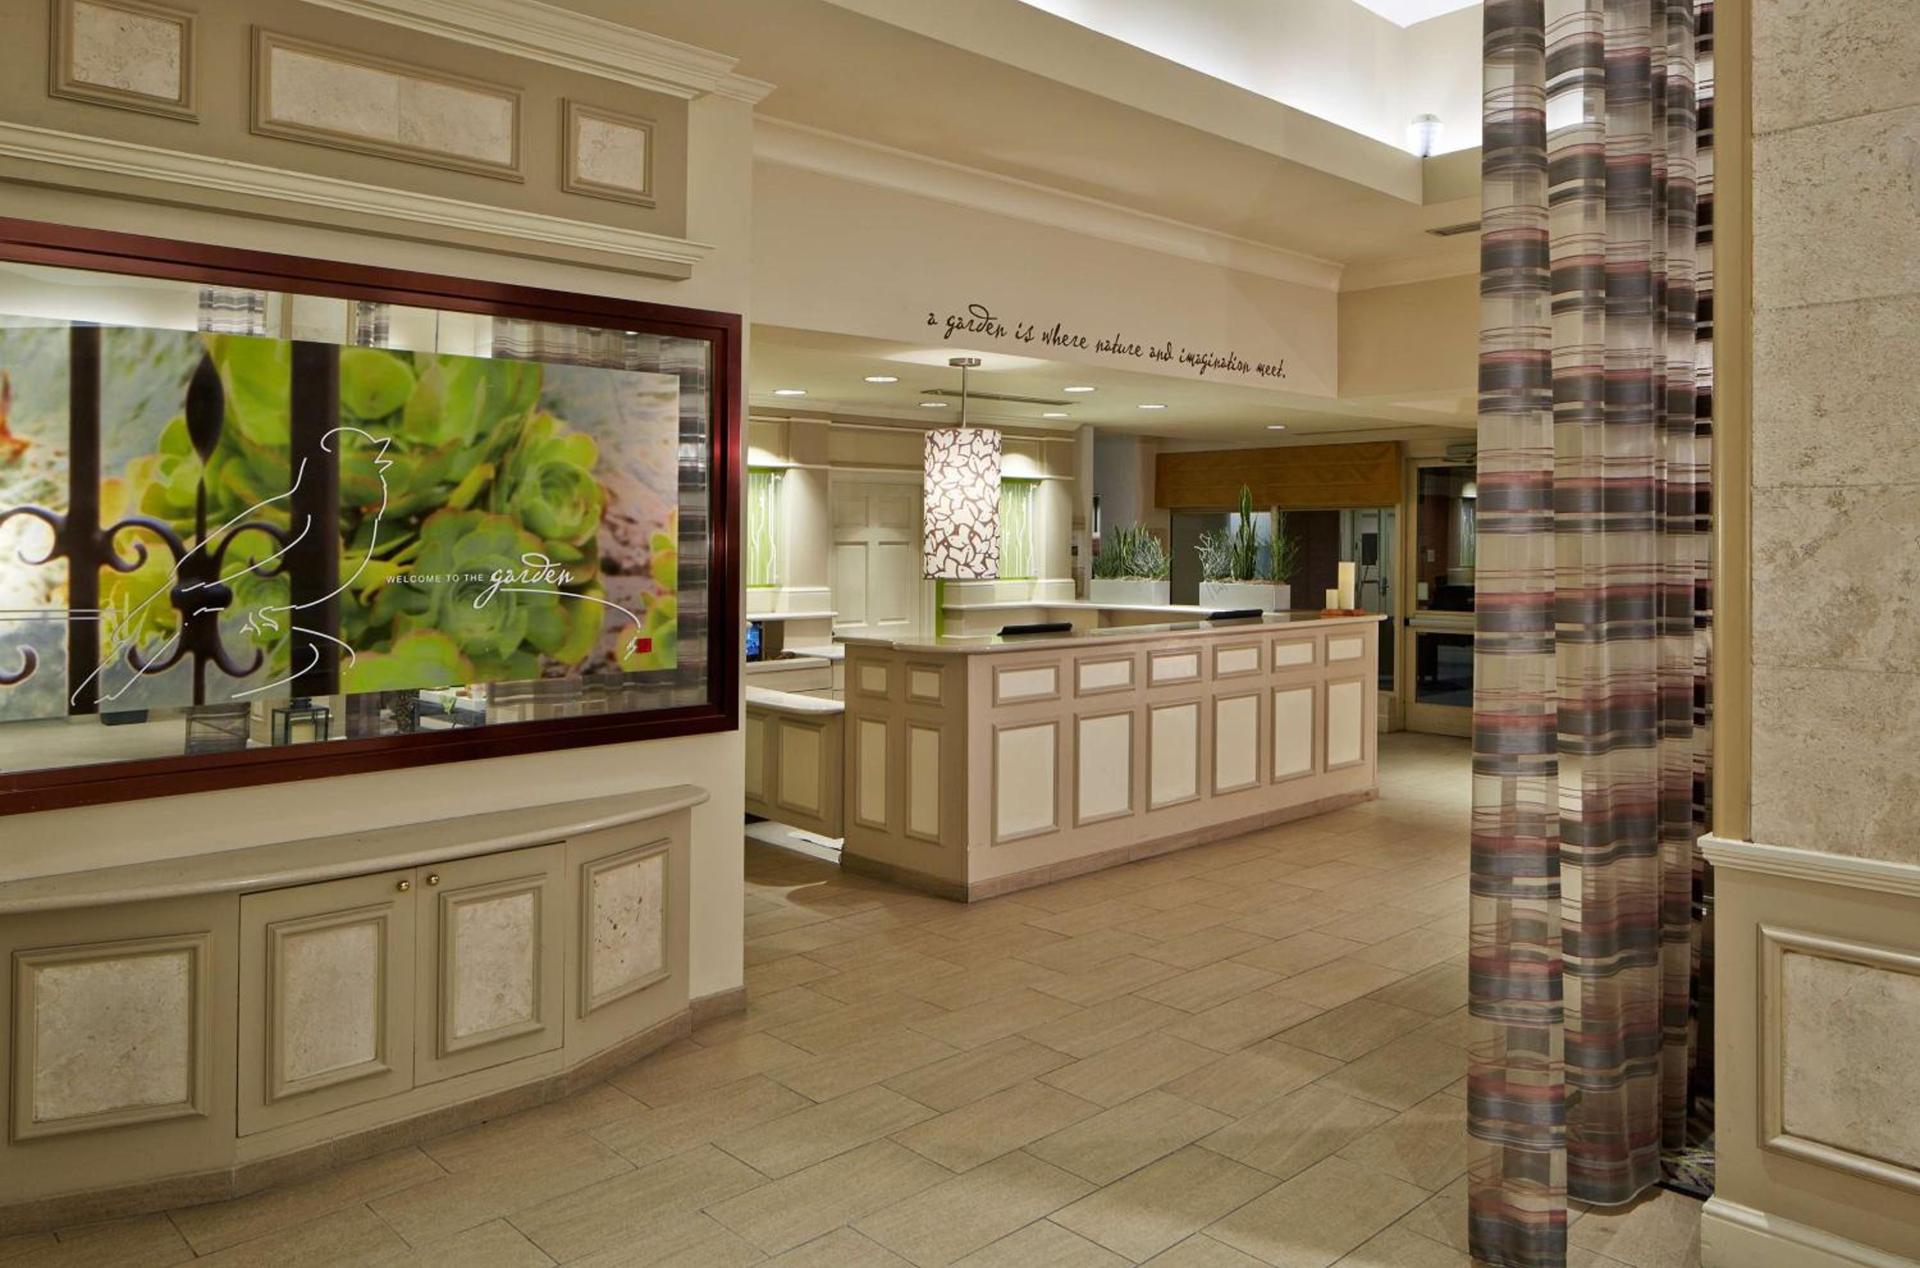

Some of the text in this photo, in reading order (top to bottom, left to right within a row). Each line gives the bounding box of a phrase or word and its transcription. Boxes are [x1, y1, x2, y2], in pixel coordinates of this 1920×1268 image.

[943, 303, 1008, 340] garden
[1014, 322, 1035, 343] is
[1041, 322, 1090, 350] where
[1095, 332, 1144, 358] nature
[1149, 341, 1175, 363] and
[1178, 347, 1252, 376] imagination
[1255, 359, 1287, 379] meet.
[385, 552, 575, 610] WELCOME TO THE garden
